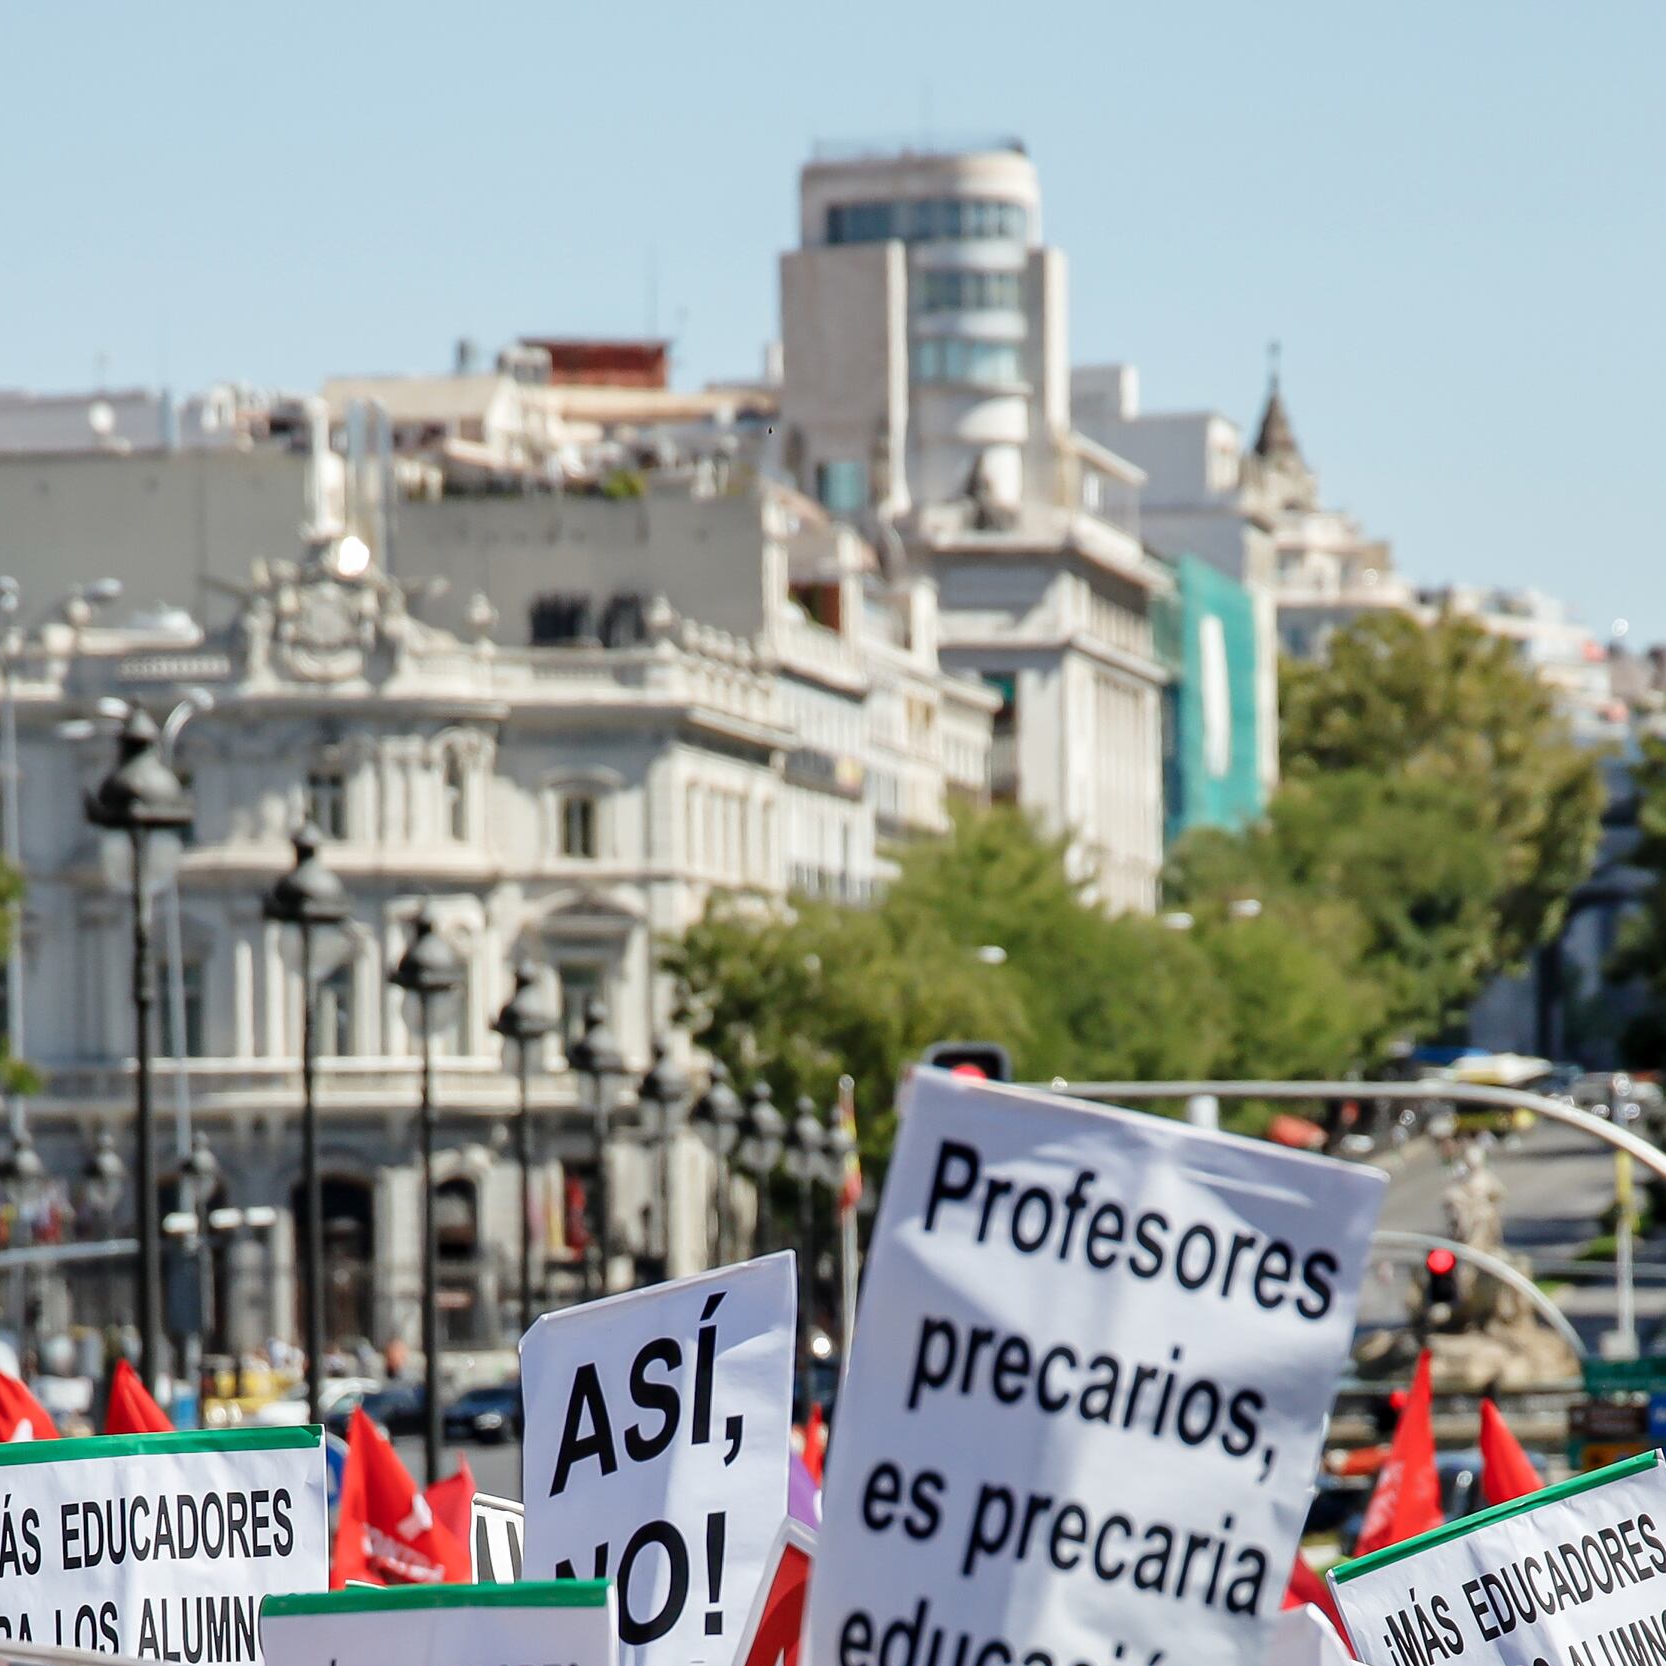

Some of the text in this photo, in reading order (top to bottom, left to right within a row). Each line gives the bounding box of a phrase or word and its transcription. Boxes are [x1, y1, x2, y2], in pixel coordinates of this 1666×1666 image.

[924, 1140, 1340, 1321] Profesores
[550, 1292, 744, 1498] ASÍ,
[906, 1314, 1275, 1483] precarios,
[61, 1488, 295, 1571] EDUCADORES
[863, 1460, 947, 1542] es
[963, 1481, 1268, 1618] precaria
[138, 1597, 265, 1663] ALUMN
